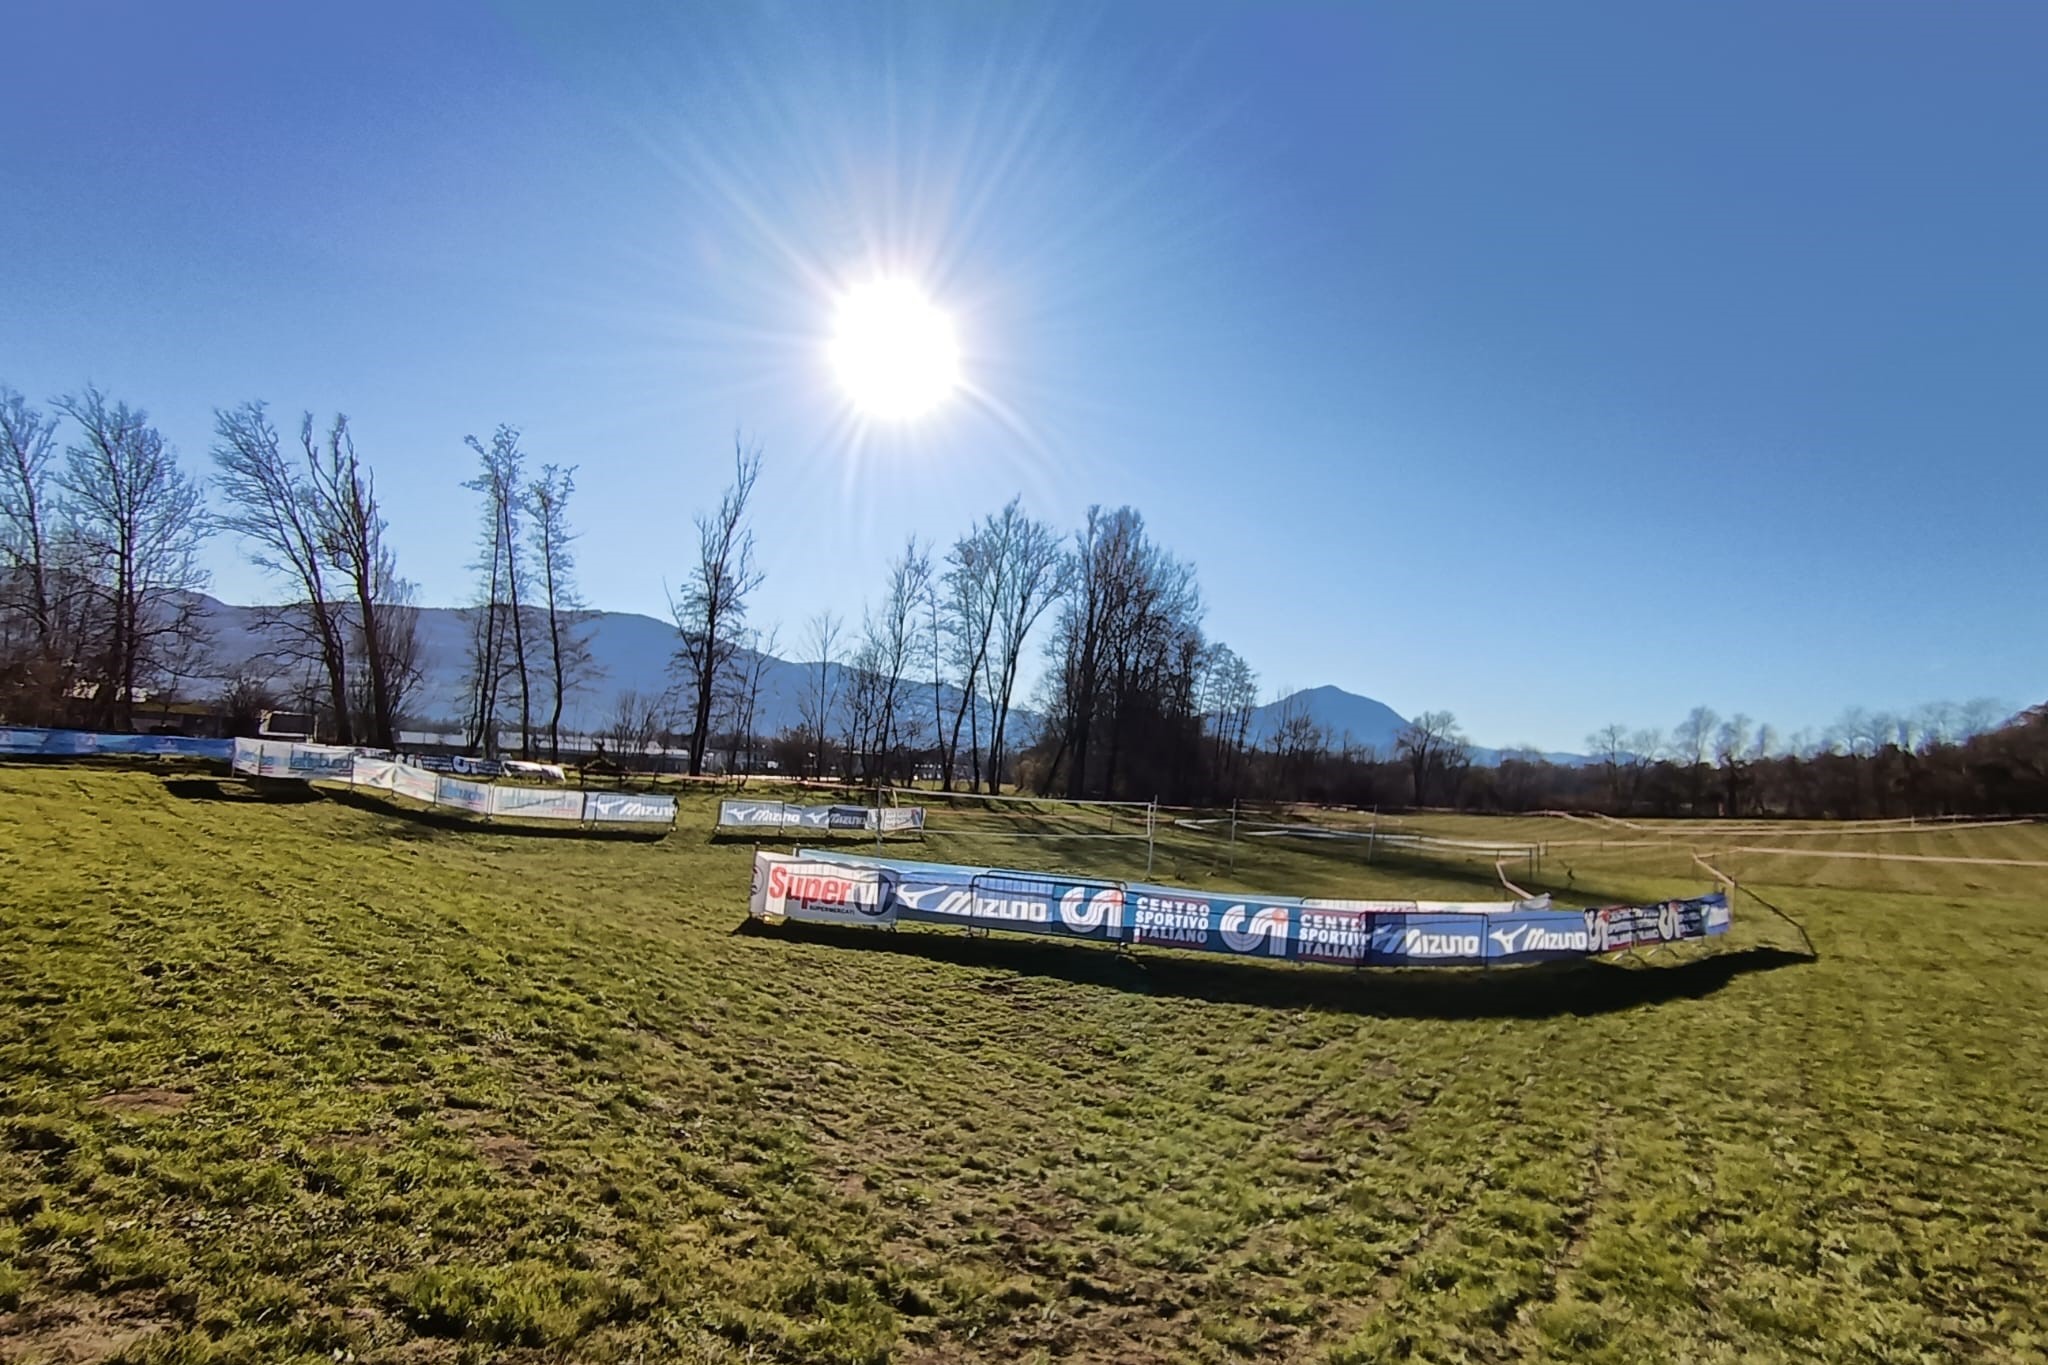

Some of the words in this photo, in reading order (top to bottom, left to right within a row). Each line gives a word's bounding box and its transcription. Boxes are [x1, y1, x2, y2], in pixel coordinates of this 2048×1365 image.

[768, 866, 852, 909] Super
[1136, 897, 1210, 917] CENTRO
[1135, 911, 1209, 930] SPORTIVO
[1133, 925, 1208, 944] ITALIANO
